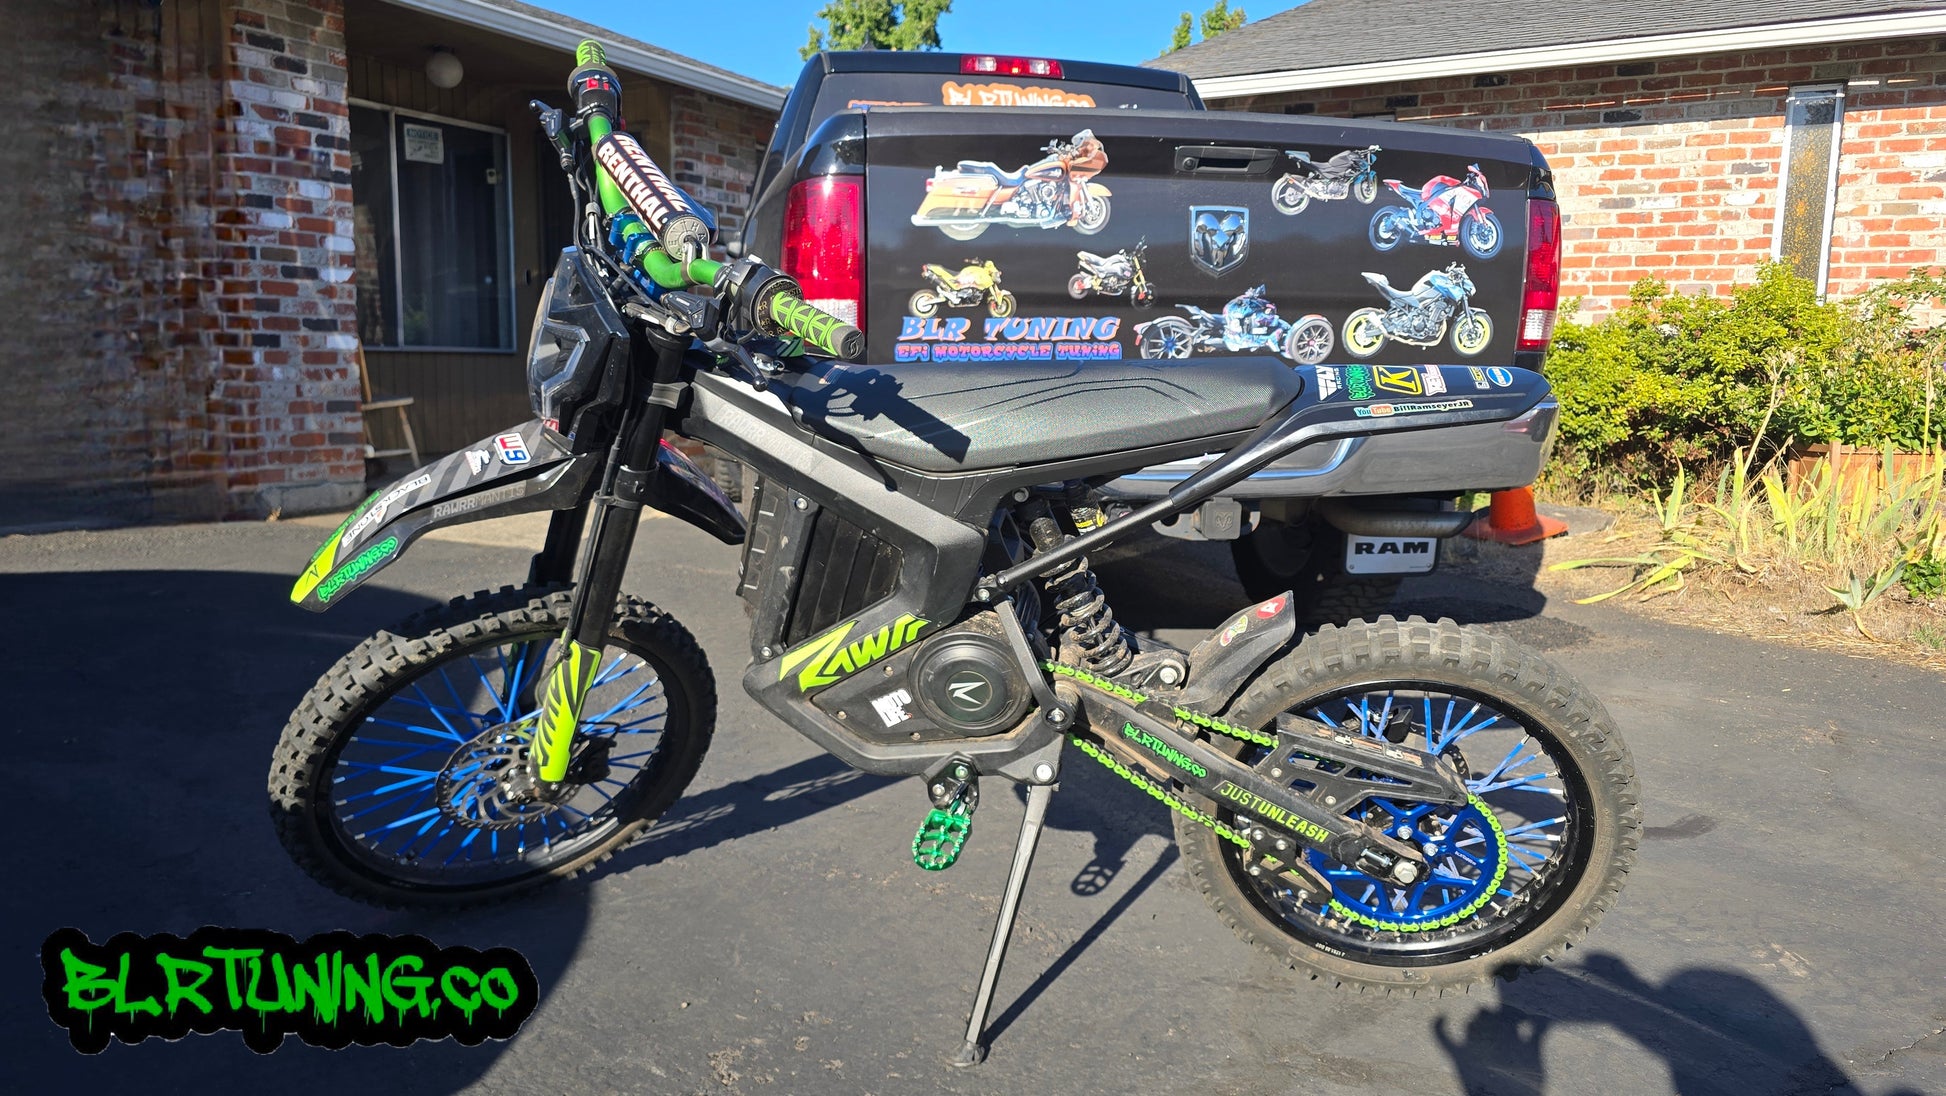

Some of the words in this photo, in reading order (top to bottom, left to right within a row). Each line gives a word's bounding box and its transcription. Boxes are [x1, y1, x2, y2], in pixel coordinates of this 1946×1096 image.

[597, 140, 671, 231] RENTHAL
[896, 316, 972, 342] BLR
[984, 316, 1121, 341] TUNING
[933, 343, 1052, 360] MOTORCYCLE
[1316, 365, 1338, 401] FLY
[1334, 367, 1344, 388] RACING
[1379, 367, 1417, 392] K
[1393, 401, 1470, 412] BillRamseyerJR
[433, 485, 526, 519] RAWRRMANTIS
[1354, 541, 1430, 555] RAM
